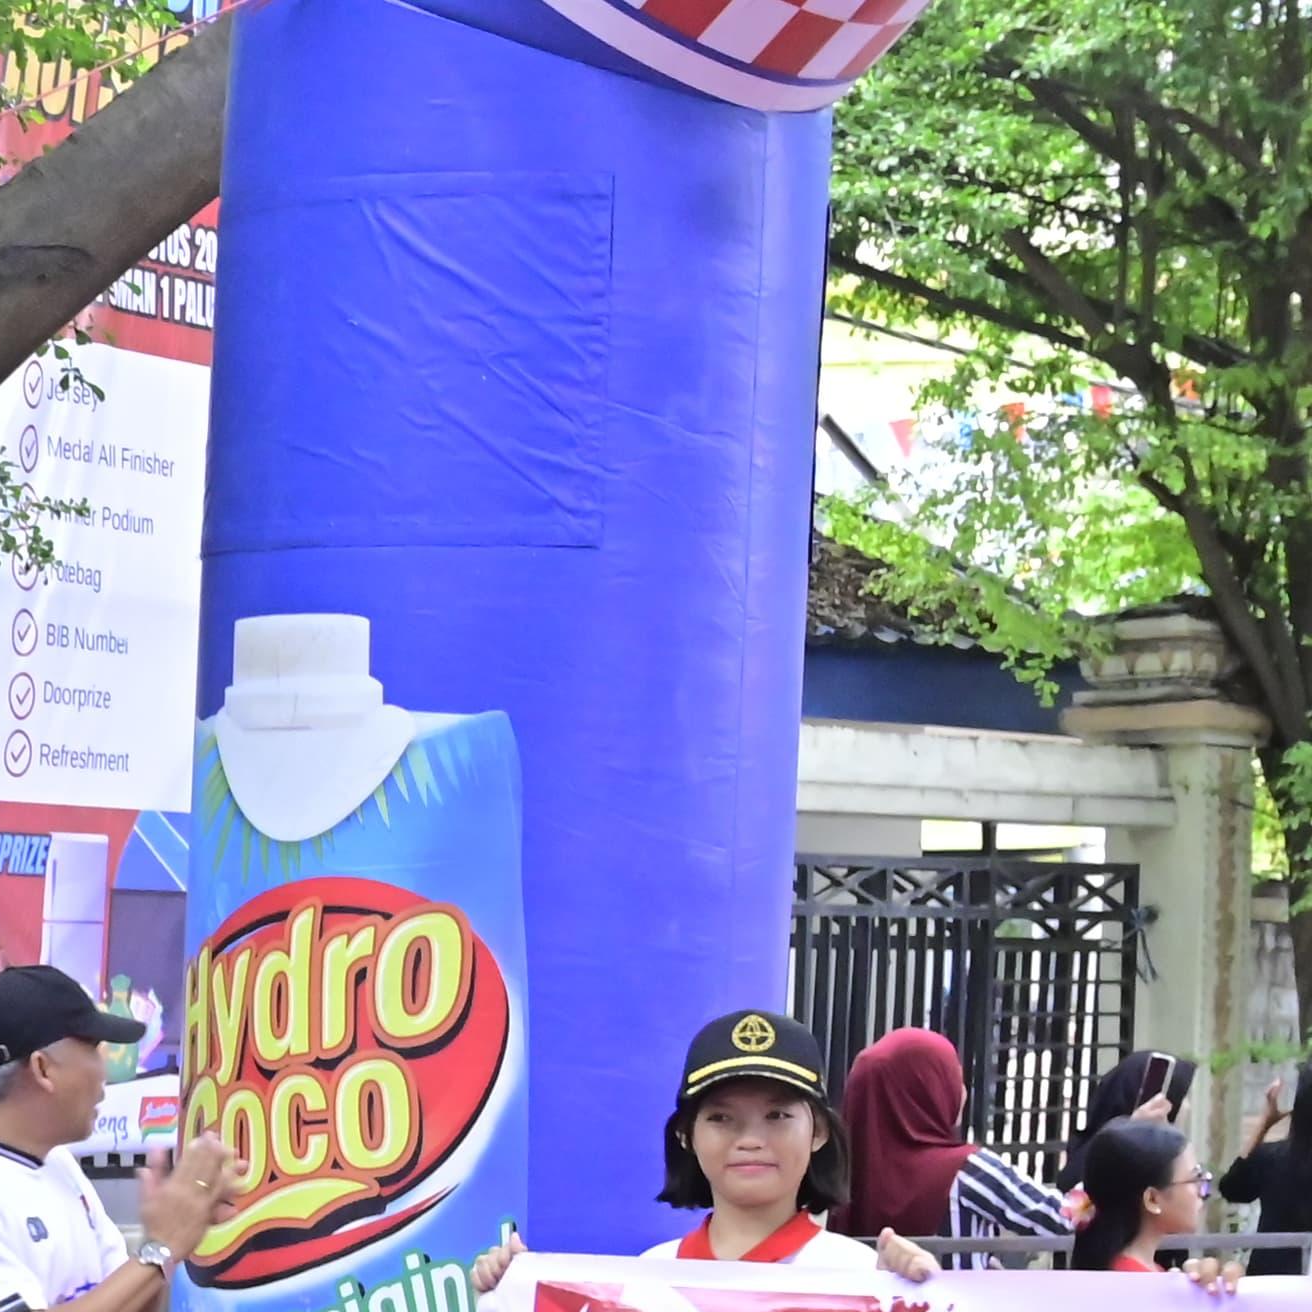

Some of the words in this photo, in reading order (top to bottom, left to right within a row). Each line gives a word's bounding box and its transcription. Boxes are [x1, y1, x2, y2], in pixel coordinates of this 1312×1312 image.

[47, 435, 94, 463] Medal
[98, 444, 116, 468] All
[121, 447, 175, 478] Finisher
[101, 506, 154, 535] Podium
[46, 623, 70, 648] BIB
[43, 680, 111, 712] Doorprize
[39, 743, 129, 772] Refreshment
[182, 905, 464, 1086] Hydro
